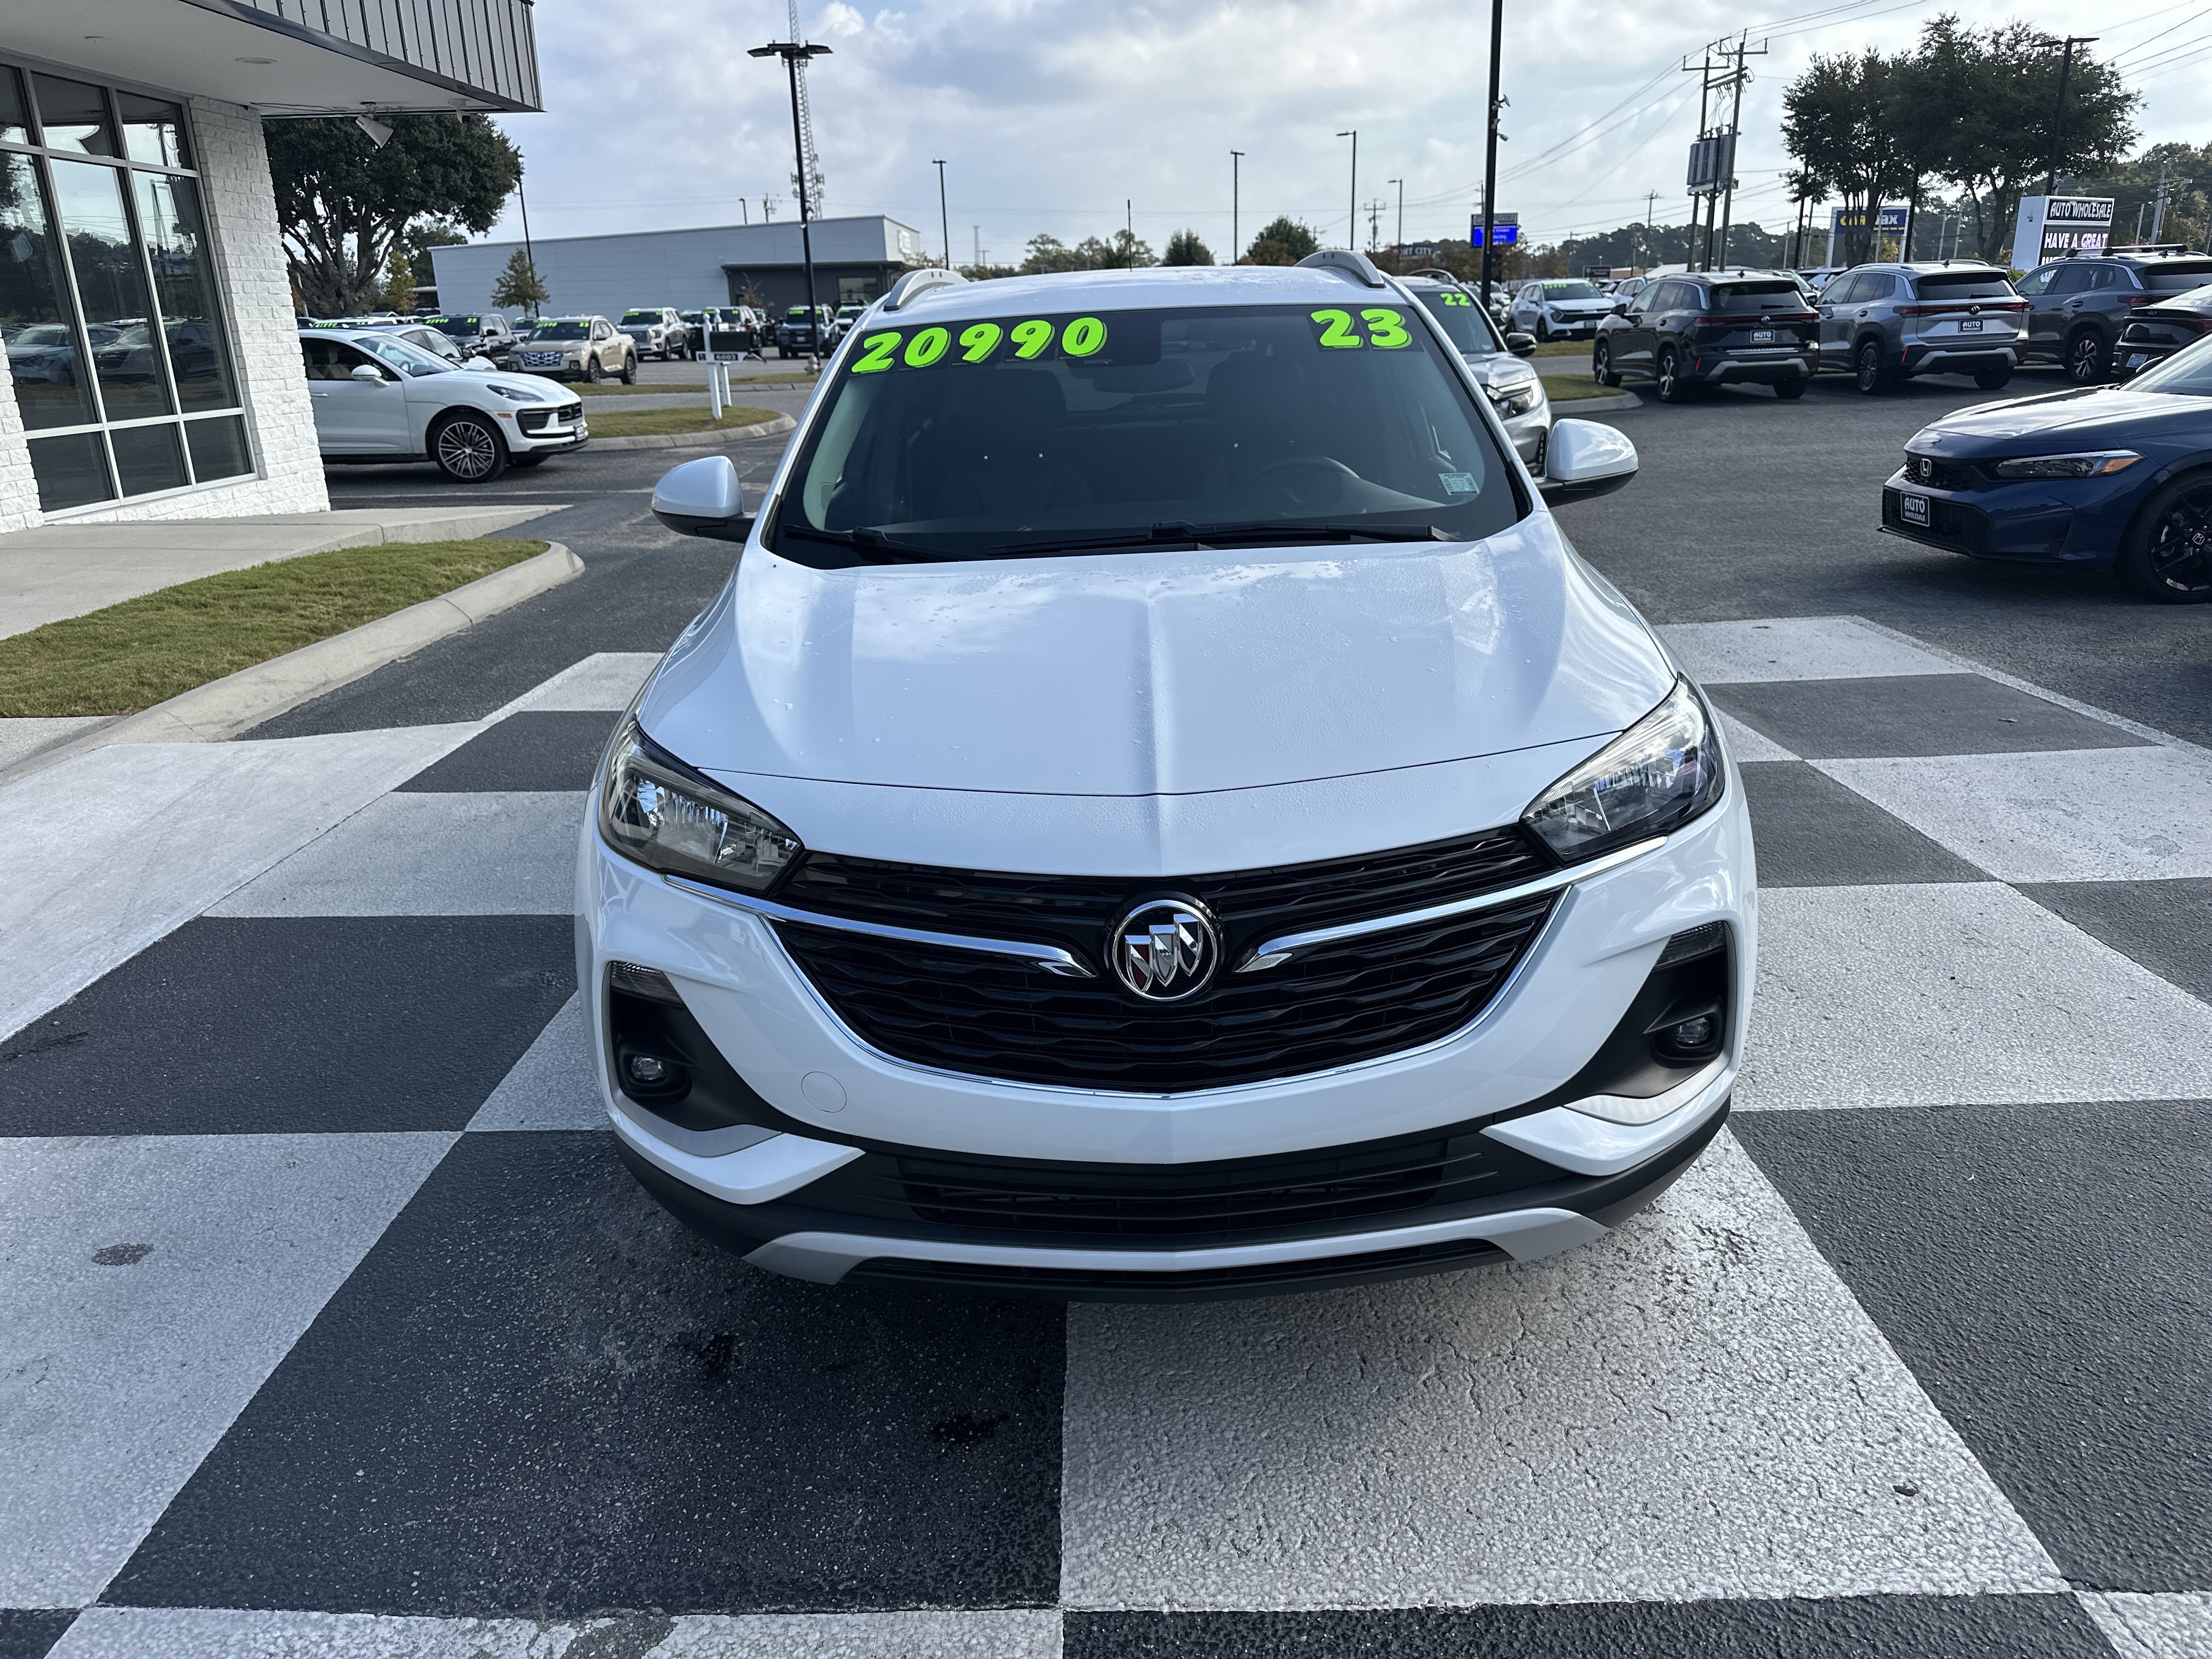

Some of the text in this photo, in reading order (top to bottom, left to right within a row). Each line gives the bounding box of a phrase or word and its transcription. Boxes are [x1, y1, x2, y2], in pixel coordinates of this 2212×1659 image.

[2050, 201, 2112, 219] AUTO WHOLESALE
[2044, 233, 2108, 249] HAVE A GREAT
[1440, 293, 1471, 306] 22
[851, 308, 1413, 374] 20990 23
[1904, 497, 1925, 513] AUTO
